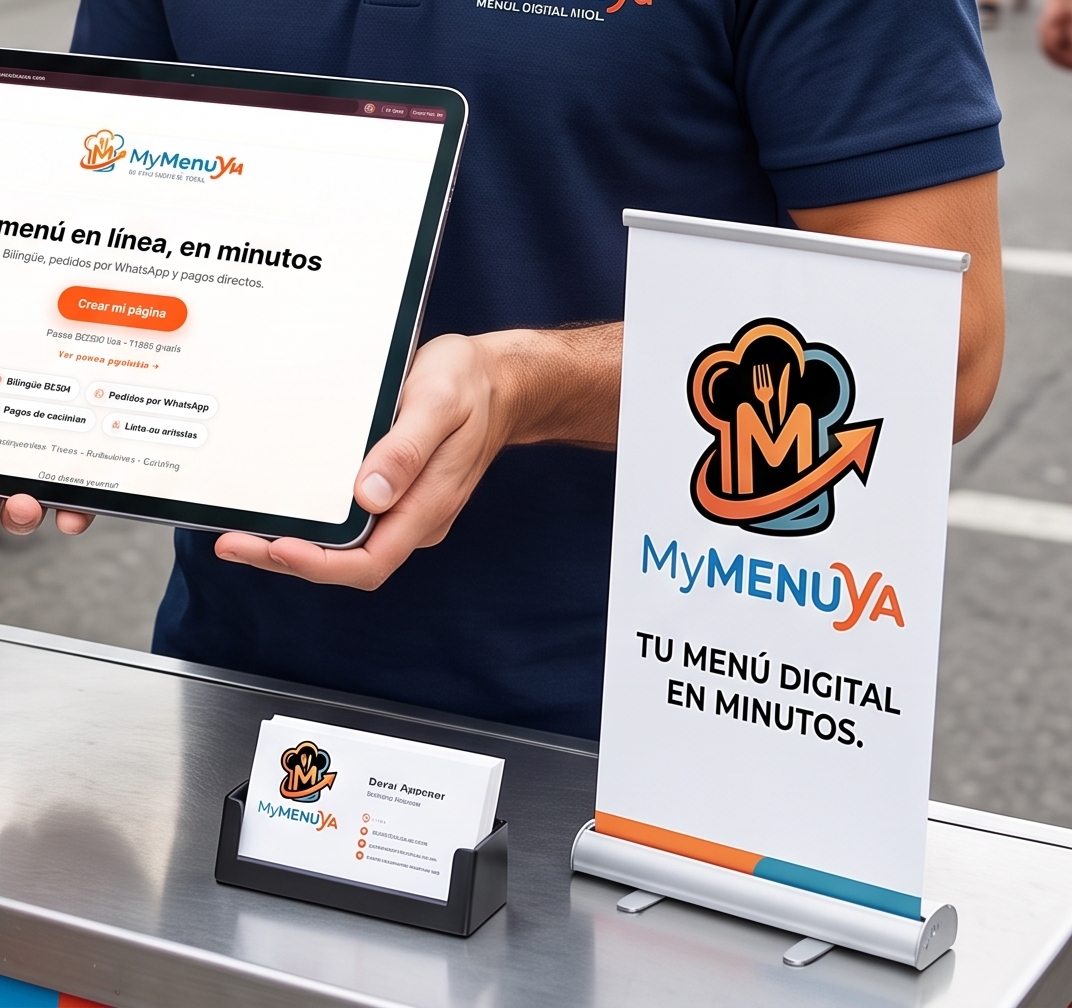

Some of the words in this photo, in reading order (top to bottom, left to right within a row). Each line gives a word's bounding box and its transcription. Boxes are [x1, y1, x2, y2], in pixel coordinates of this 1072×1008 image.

[70, 227, 101, 246] en
[107, 227, 173, 259] línea,
[179, 241, 211, 258] en
[216, 242, 323, 272] minutos
[2, 248, 46, 265] Bilingüe,
[48, 255, 92, 270] pedidos
[93, 261, 113, 271] por
[114, 261, 170, 279] WhatsApp
[171, 270, 179, 281] y
[180, 271, 215, 284] pagos
[217, 274, 265, 289] directos.
[78, 298, 110, 311] Crear
[111, 303, 126, 314] mi
[127, 305, 167, 319] página
[6, 377, 42, 390] Bilingüe
[3, 405, 32, 418] Pagos
[33, 410, 45, 419] de
[108, 391, 145, 404] Pedidos
[146, 397, 162, 406] por
[163, 398, 209, 413] WhatsApp
[642, 534, 905, 632] MyMENUYA
[636, 631, 674, 663] TU
[683, 641, 770, 684] MENÚ
[779, 663, 901, 716] DIGITAL
[667, 679, 705, 712] EN
[715, 689, 864, 748] MINUTOS.
[258, 800, 338, 831] MyMENUYA
